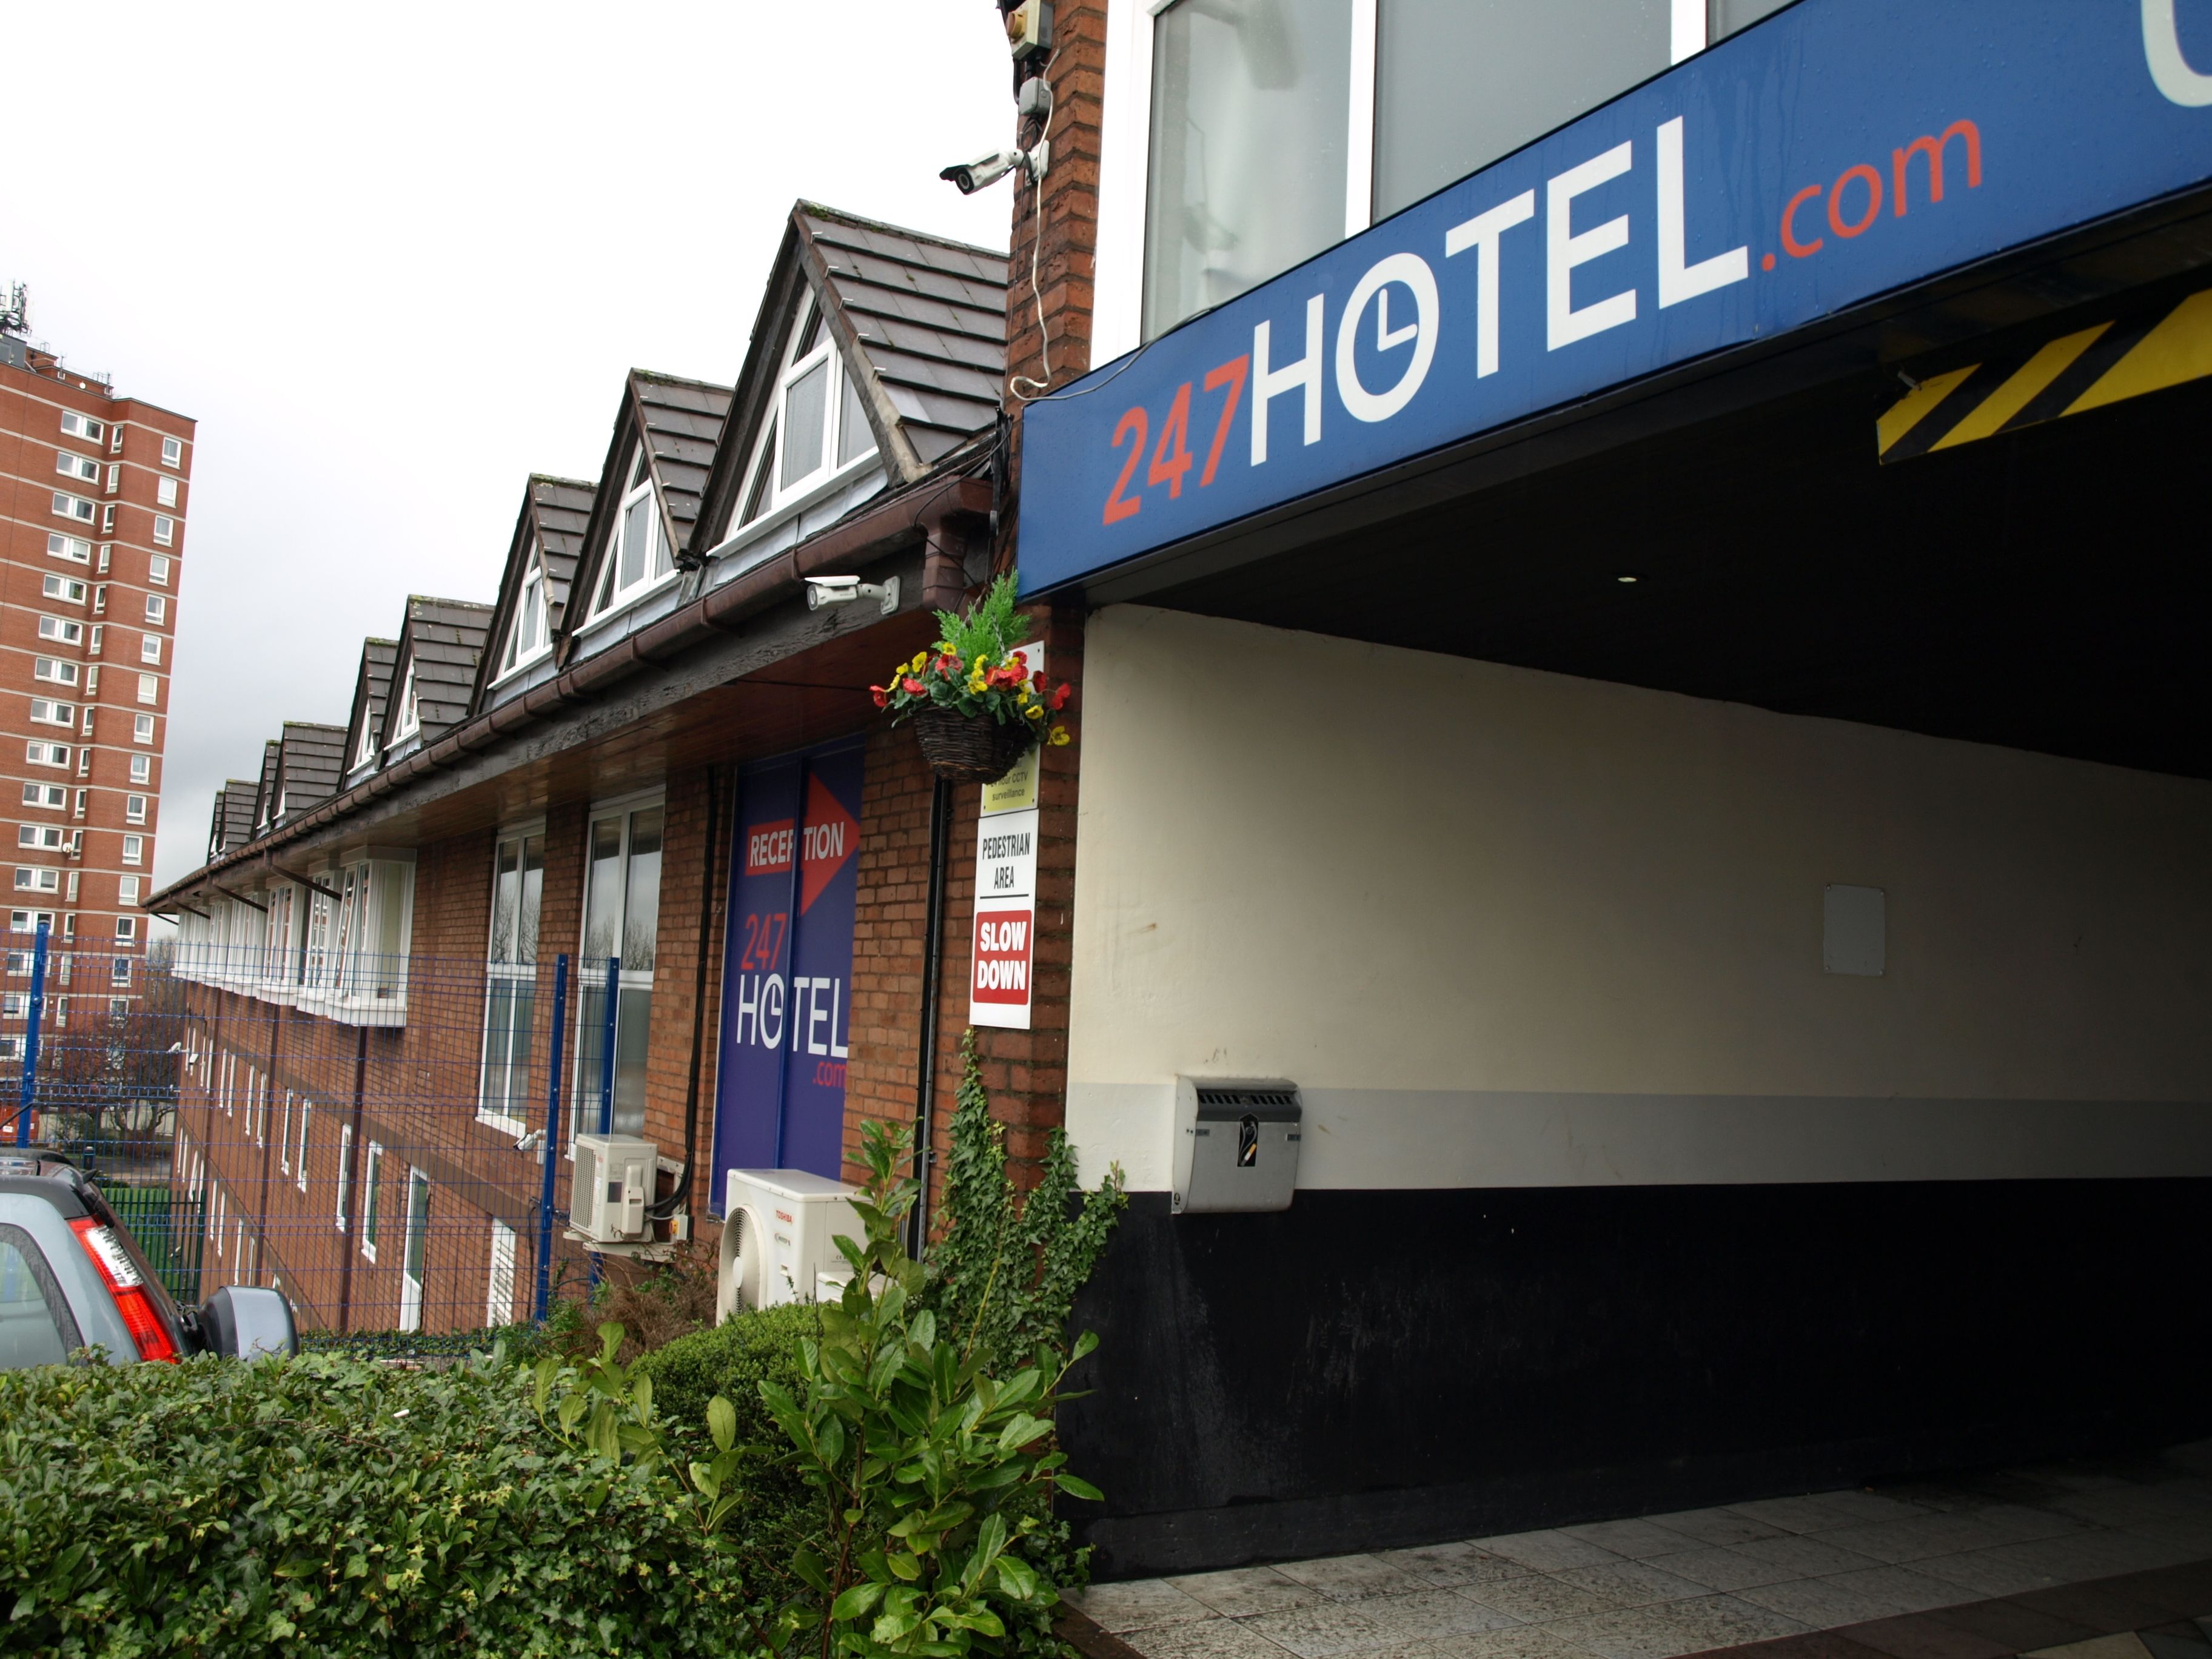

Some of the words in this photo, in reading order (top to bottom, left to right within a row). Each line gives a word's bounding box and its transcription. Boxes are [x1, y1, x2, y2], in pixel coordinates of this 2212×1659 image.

[1012, 771, 1028, 783] CCTV
[993, 789, 1025, 801] surveillance
[982, 833, 1031, 860] PEDESTRIAN
[994, 866, 1014, 889] AREA
[741, 913, 787, 970] 247
[980, 921, 1027, 952] SLOW
[977, 959, 1027, 990] DOWN
[737, 973, 848, 1059] HOTEL
[776, 1210, 792, 1223] TOSHIBA
